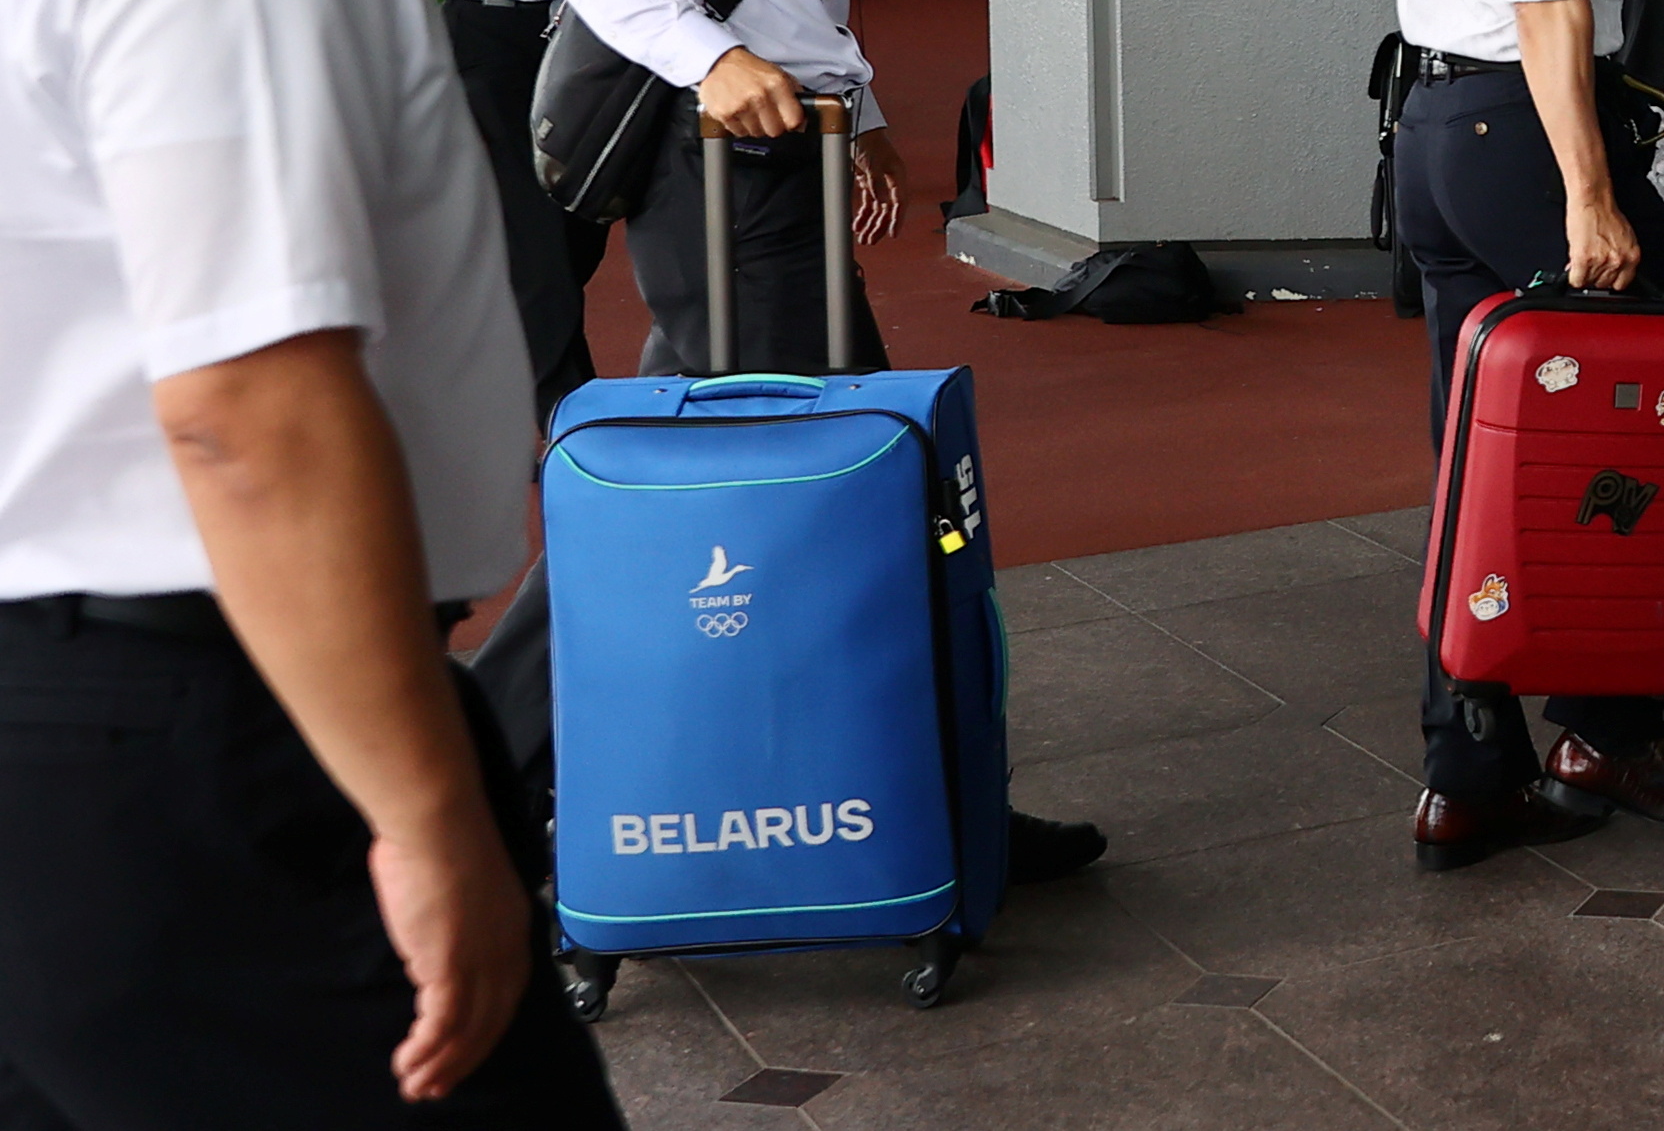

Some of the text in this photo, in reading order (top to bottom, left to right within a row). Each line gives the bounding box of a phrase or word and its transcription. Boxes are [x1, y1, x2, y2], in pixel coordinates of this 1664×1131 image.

[956, 454, 982, 540] 115
[689, 594, 752, 609] TEAM BY
[612, 799, 873, 855] BELARUS
